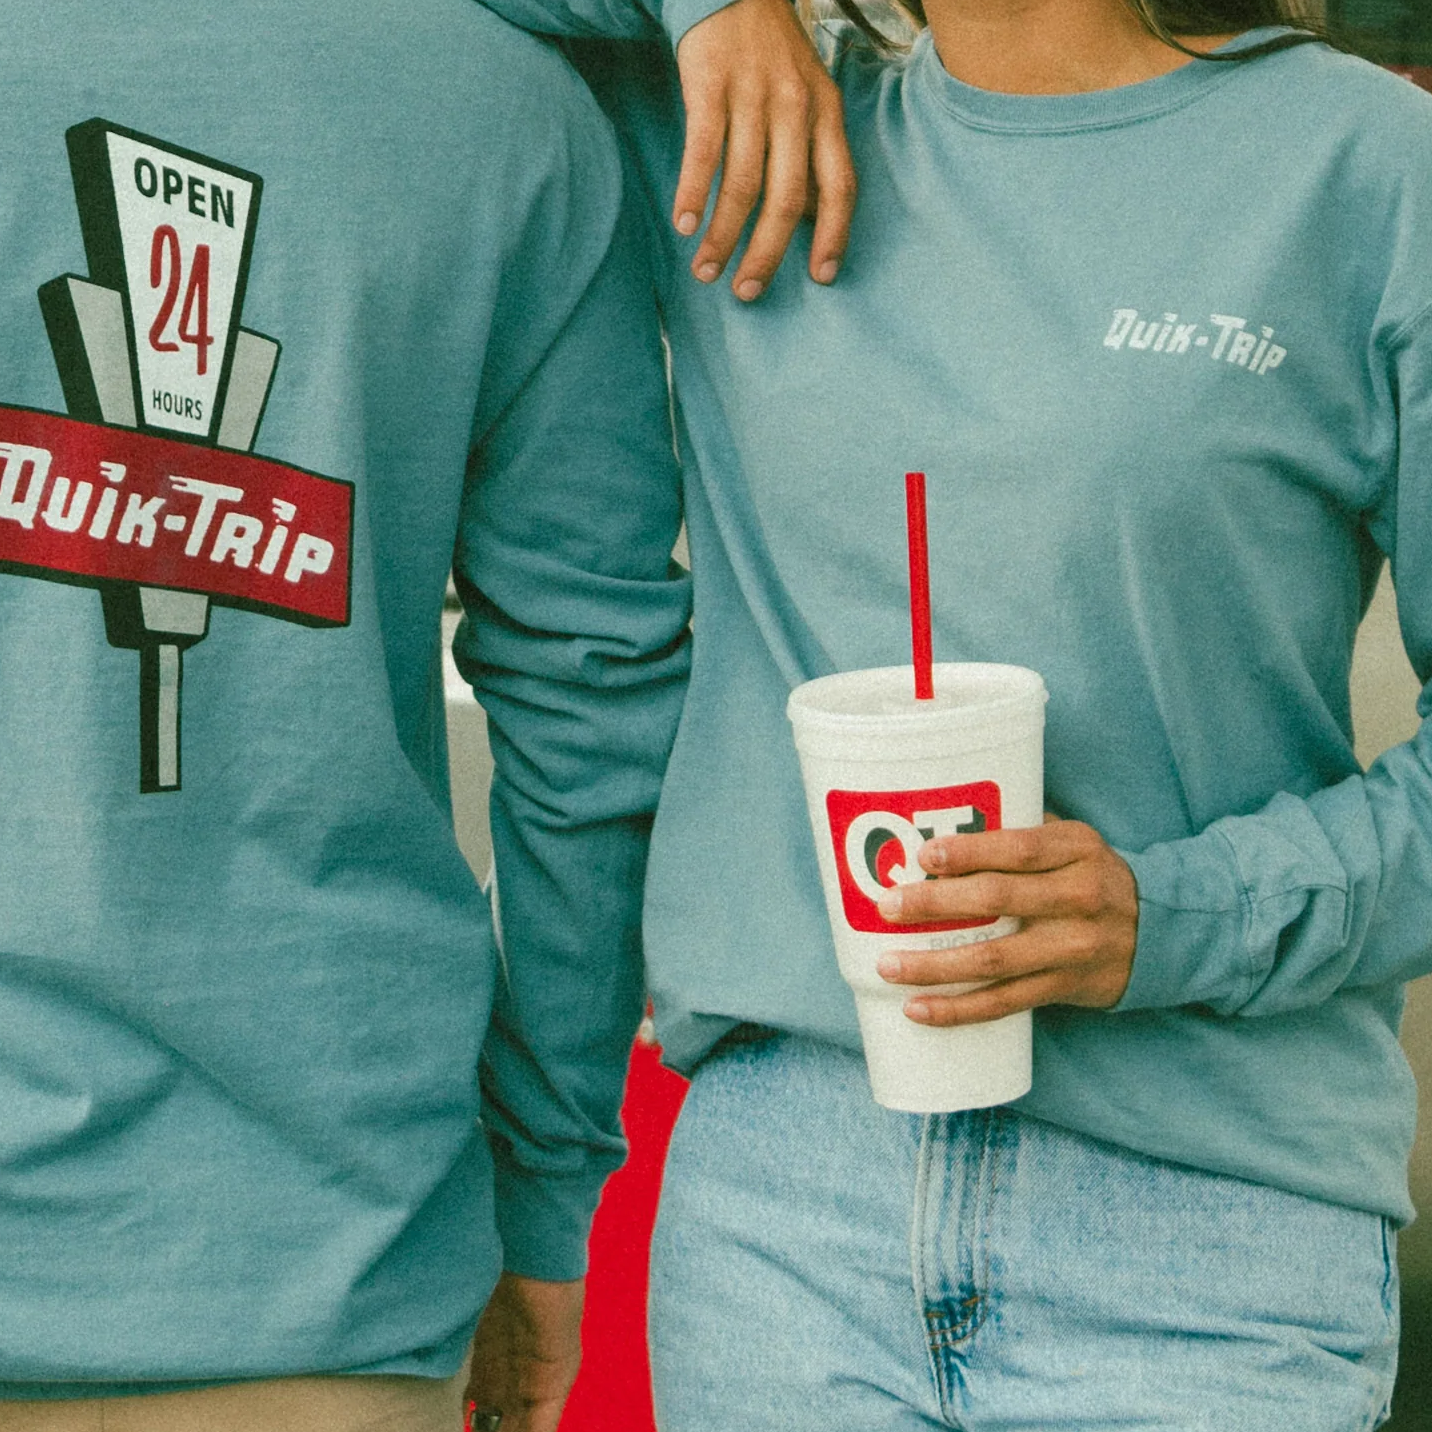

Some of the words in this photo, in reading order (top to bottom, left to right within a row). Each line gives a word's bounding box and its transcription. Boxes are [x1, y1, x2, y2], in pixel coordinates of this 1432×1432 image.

[133, 157, 235, 229] OPEN
[148, 224, 215, 376] 24
[152, 389, 204, 421] HOURS
